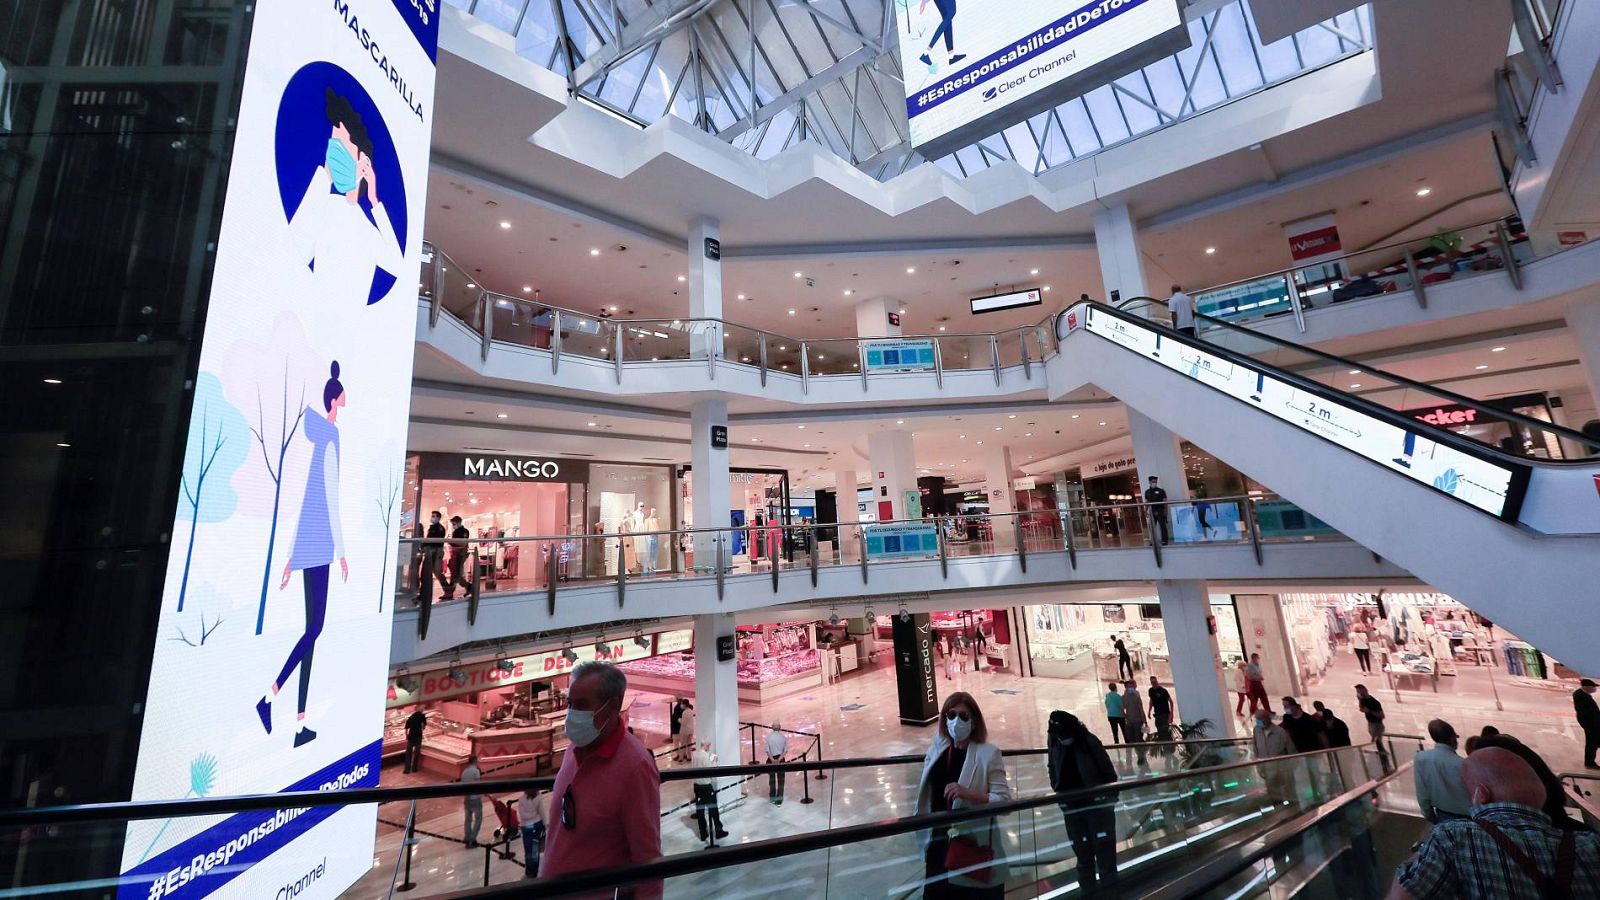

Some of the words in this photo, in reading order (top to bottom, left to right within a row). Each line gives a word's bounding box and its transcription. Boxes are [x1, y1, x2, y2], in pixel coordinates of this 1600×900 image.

[334, 0, 424, 123] MASCARILLA
[997, 74, 1027, 94] Clear
[1029, 49, 1077, 79] Channel
[1114, 322, 1119, 330] 2
[1196, 355, 1201, 364] 2
[1202, 360, 1211, 369] m
[1308, 402, 1315, 413] 2
[1319, 408, 1330, 419] m
[464, 457, 560, 479] MANGO
[921, 639, 934, 703] mercado
[276, 856, 327, 900] Channel
